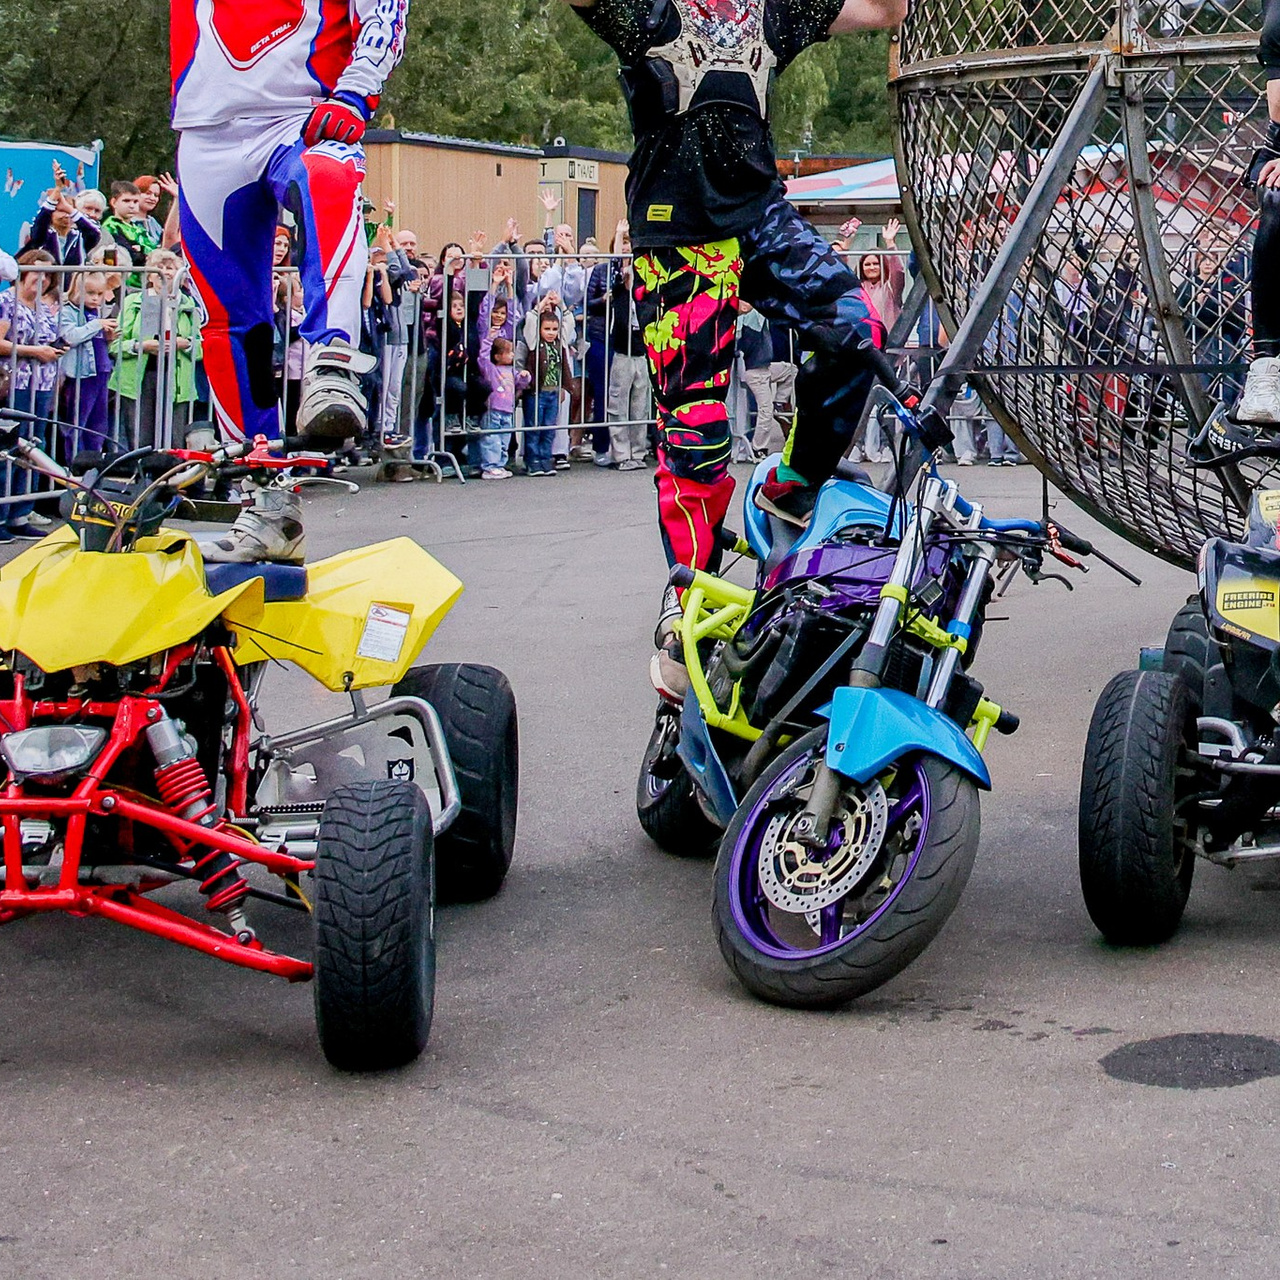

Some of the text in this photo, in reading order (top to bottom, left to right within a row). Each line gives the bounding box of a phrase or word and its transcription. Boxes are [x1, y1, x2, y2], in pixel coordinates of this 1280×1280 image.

[250, 22, 292, 53] BETA TRIAL
[1224, 592, 1274, 602] FREERIDE
